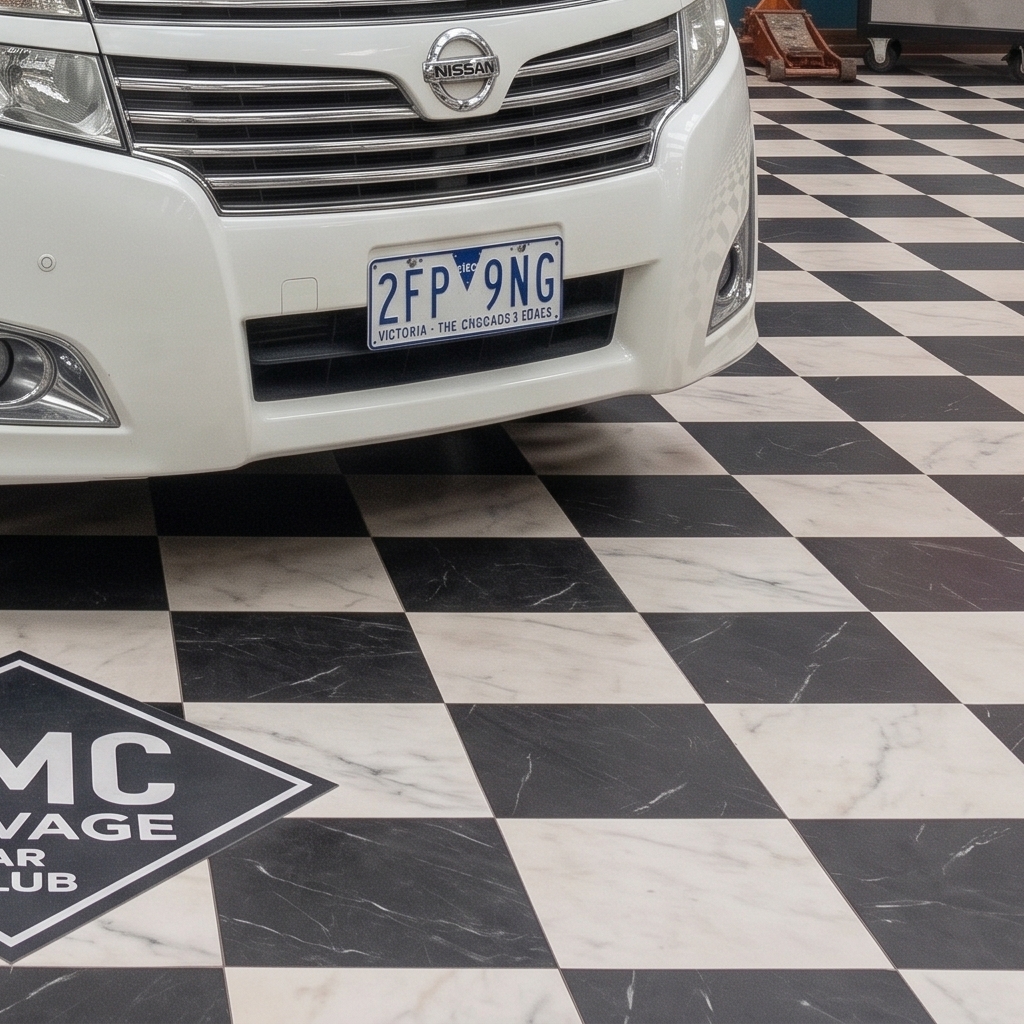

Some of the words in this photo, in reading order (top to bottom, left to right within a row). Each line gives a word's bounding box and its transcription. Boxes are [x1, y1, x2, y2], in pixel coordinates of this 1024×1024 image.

[434, 60, 495, 78] NISSAN
[378, 265, 450, 325] 2FP
[484, 252, 555, 311] 9NG
[378, 324, 427, 342] VICTORIA
[438, 319, 457, 333] THE
